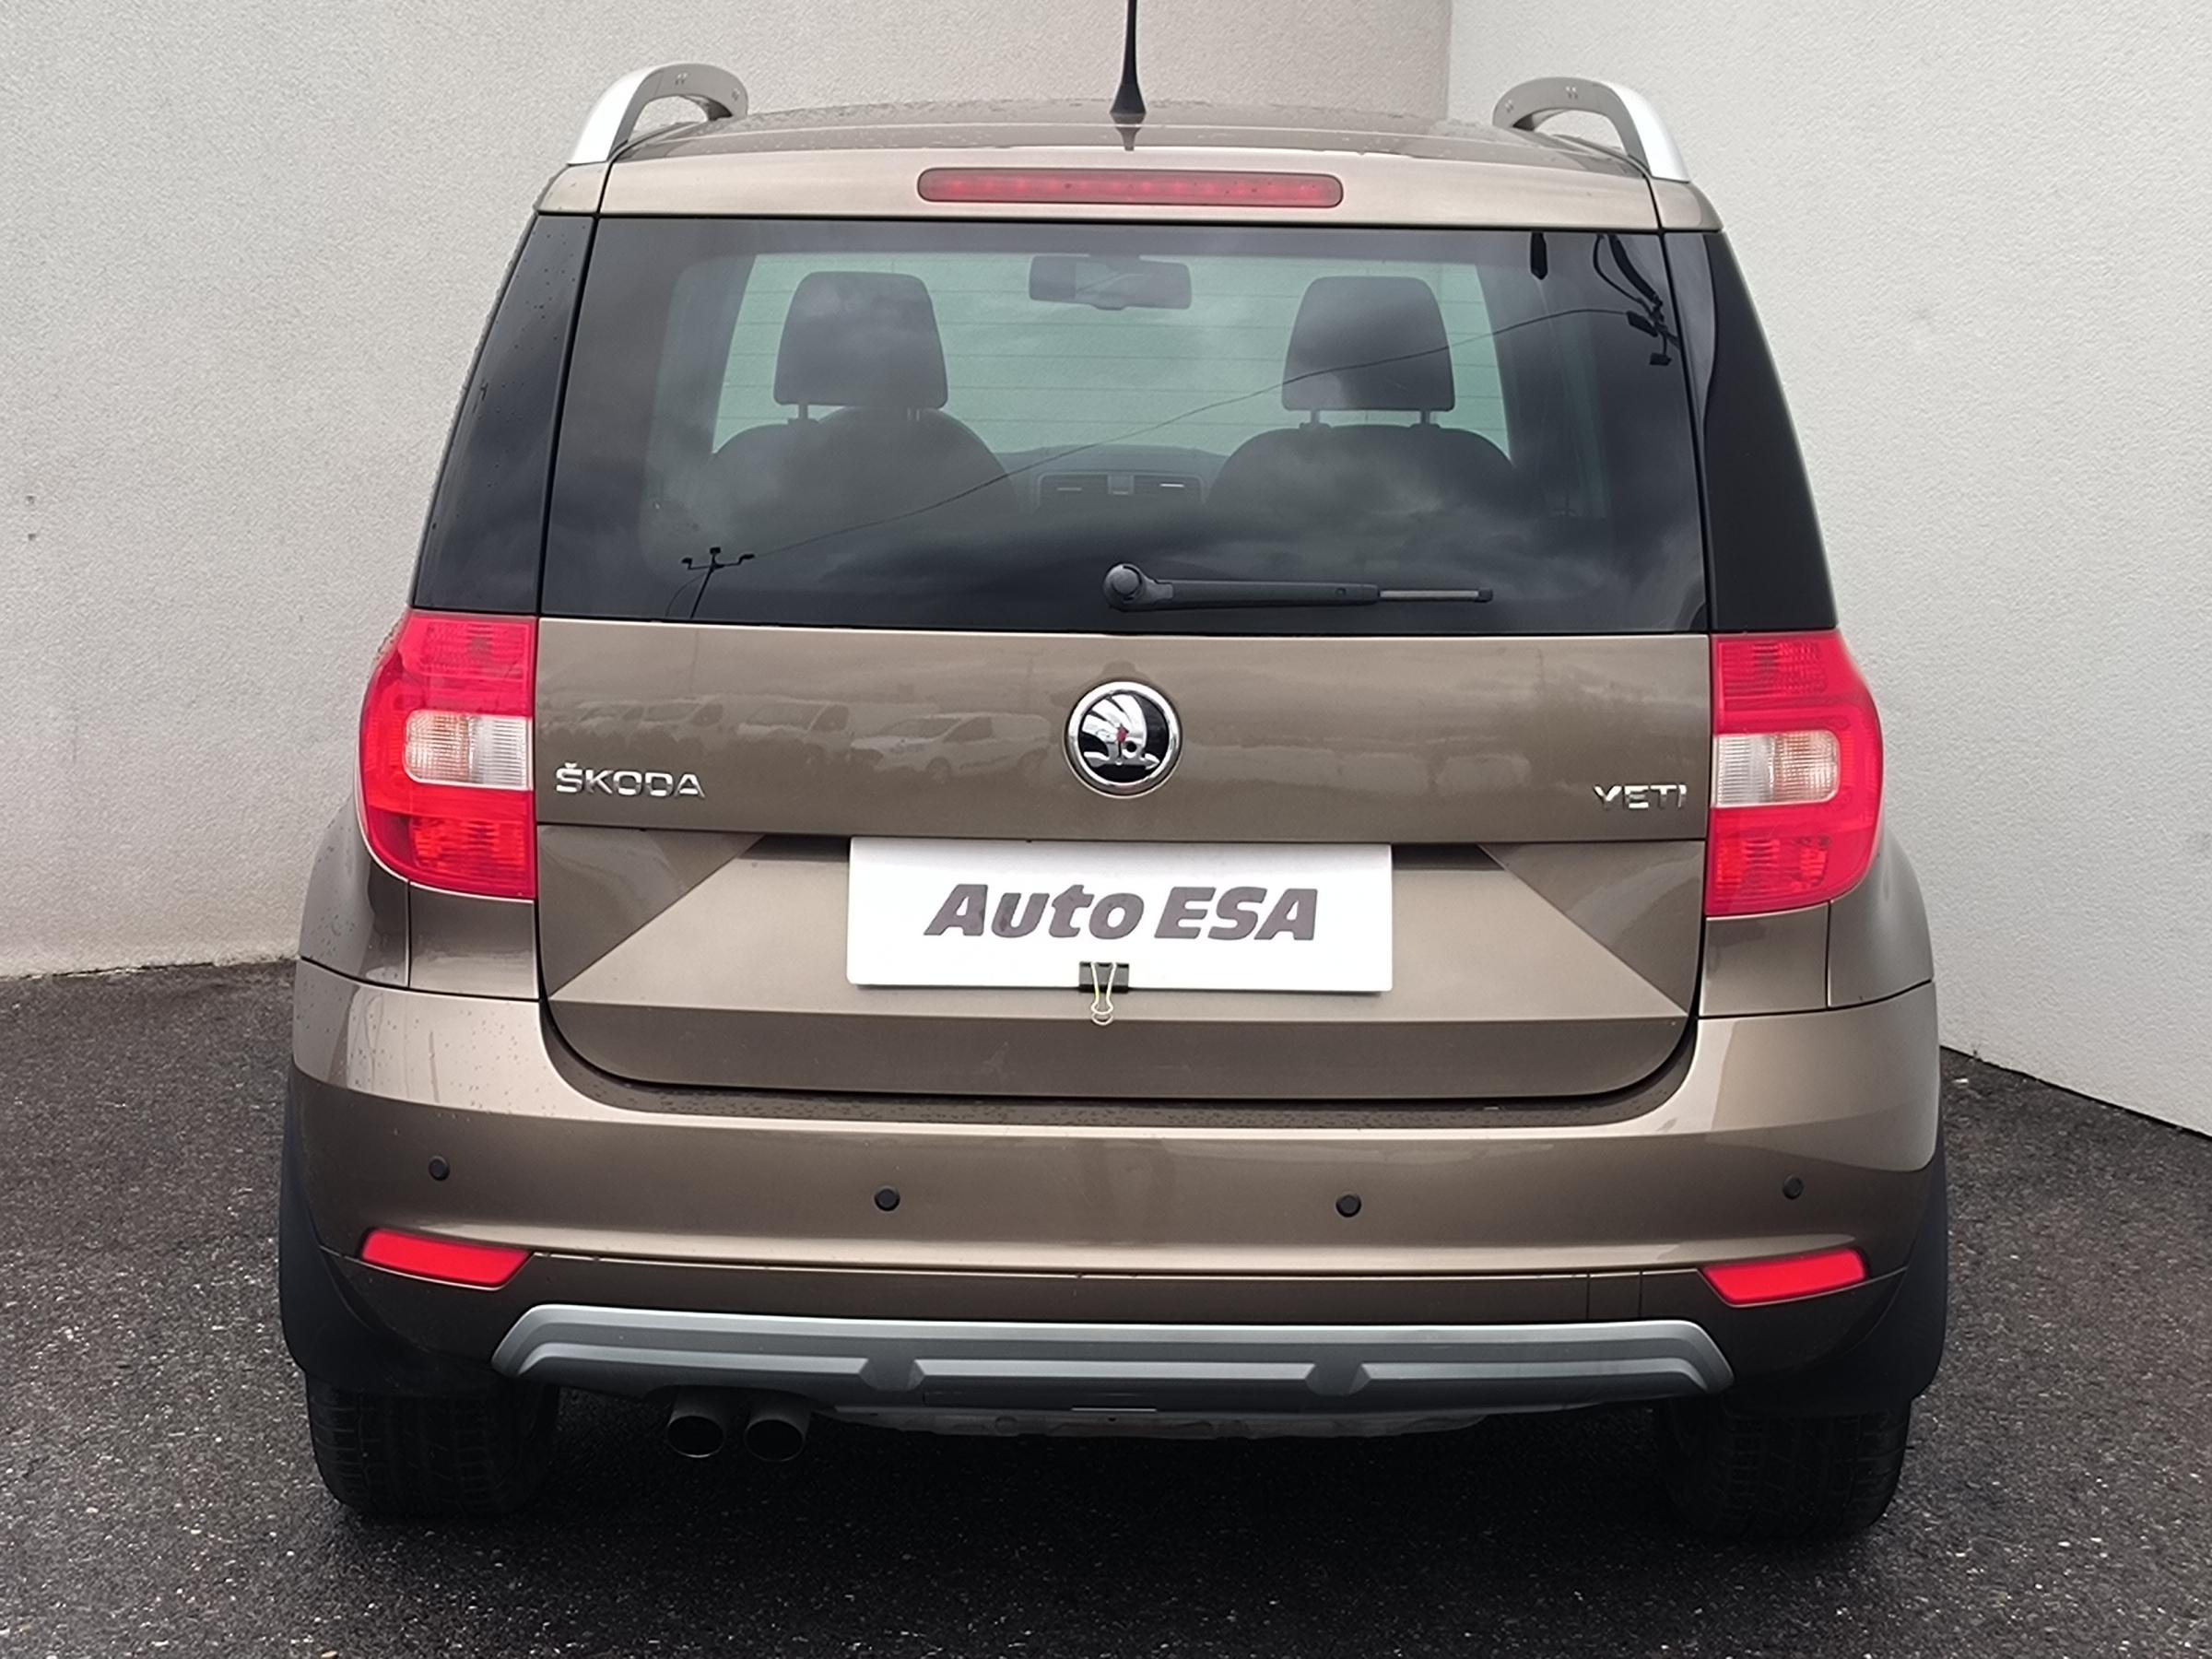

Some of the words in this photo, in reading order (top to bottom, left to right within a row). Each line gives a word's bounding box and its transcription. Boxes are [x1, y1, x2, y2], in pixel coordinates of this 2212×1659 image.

[555, 761, 706, 799] ŠKODA
[1593, 783, 1688, 810] YETI
[923, 883, 1144, 939] Auto
[1154, 886, 1318, 941] ESA
